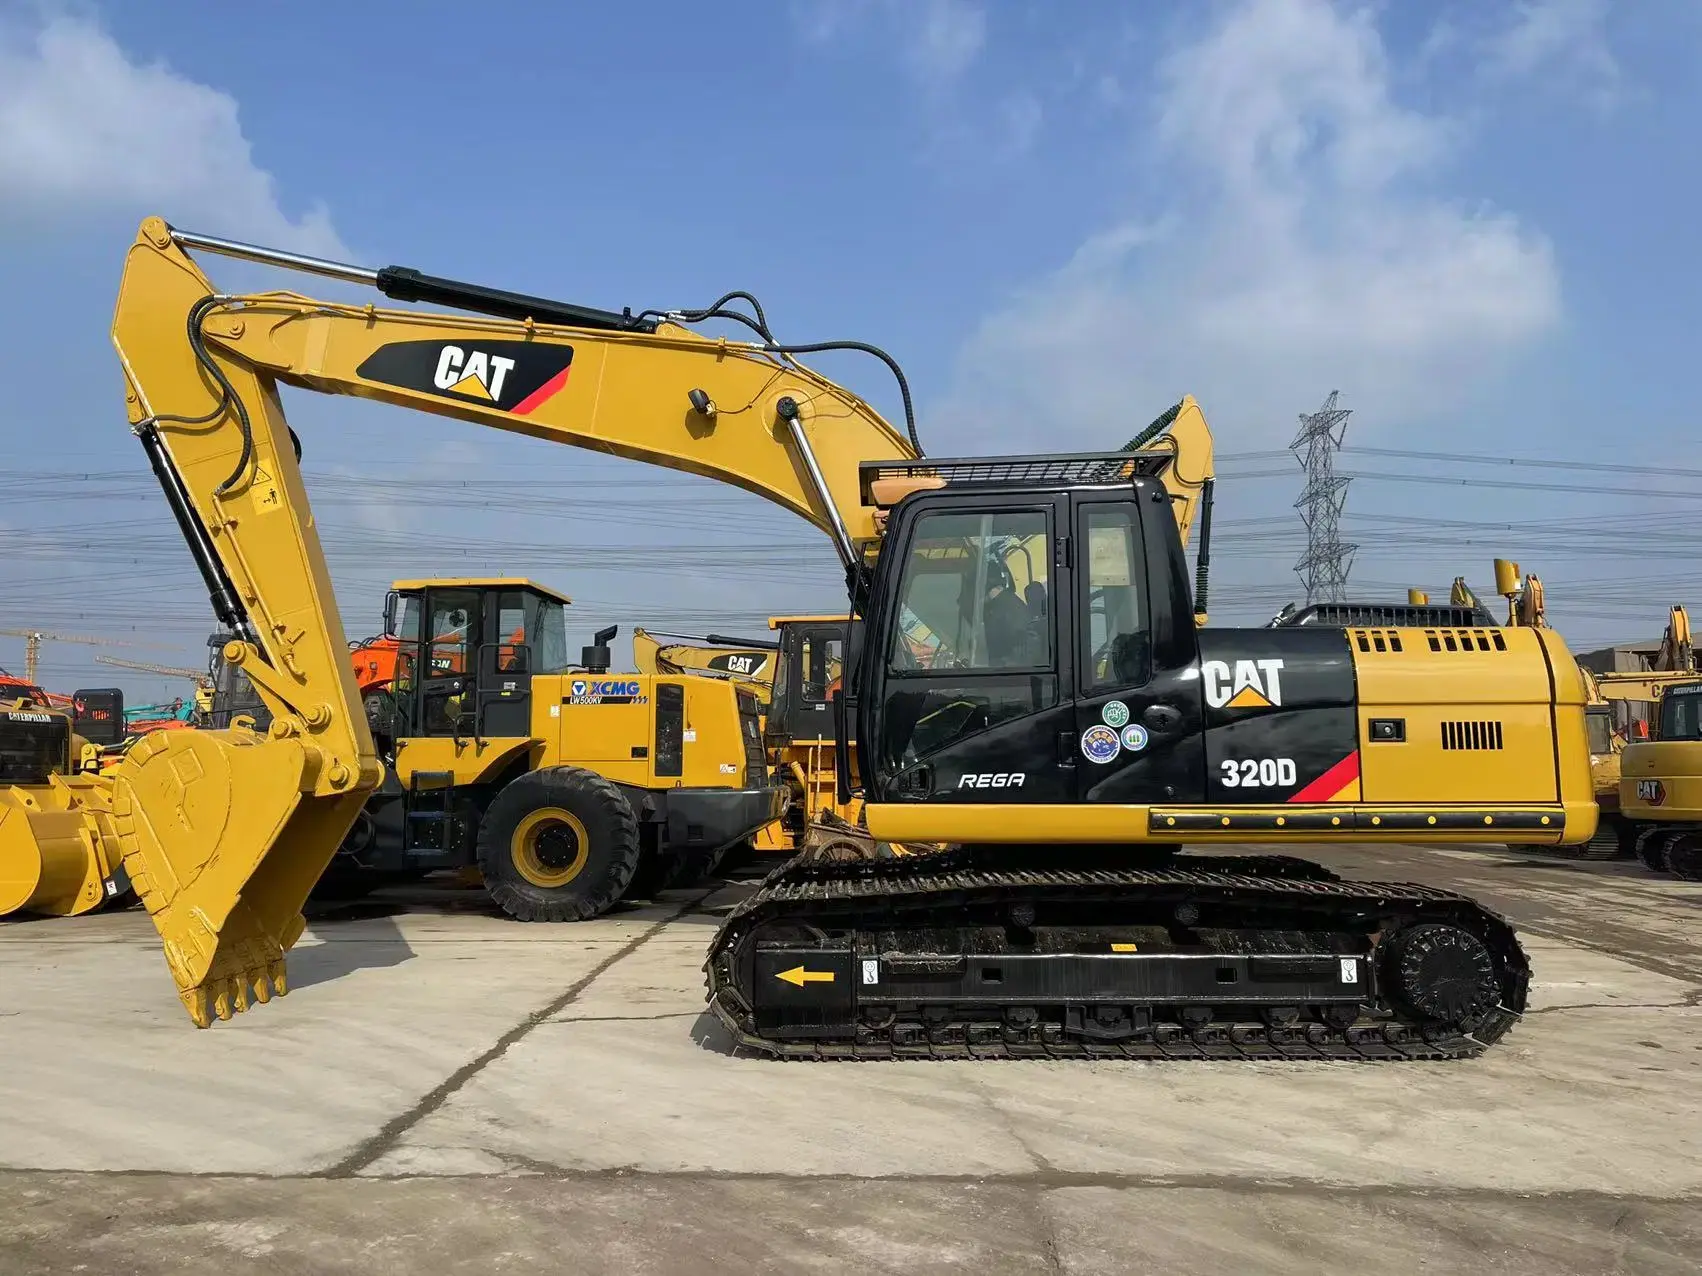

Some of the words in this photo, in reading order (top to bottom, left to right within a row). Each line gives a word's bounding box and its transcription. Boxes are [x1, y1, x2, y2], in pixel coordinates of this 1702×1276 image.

[434, 345, 515, 402] CAT
[727, 655, 753, 673] CAT
[589, 681, 640, 696] XCMG
[1202, 659, 1284, 709] CAT
[569, 696, 603, 705] LW500KV
[8, 711, 52, 723] CATERPILLAR
[957, 773, 1026, 788] REGA
[1221, 758, 1297, 787] 320D
[1637, 780, 1658, 800] CAT
